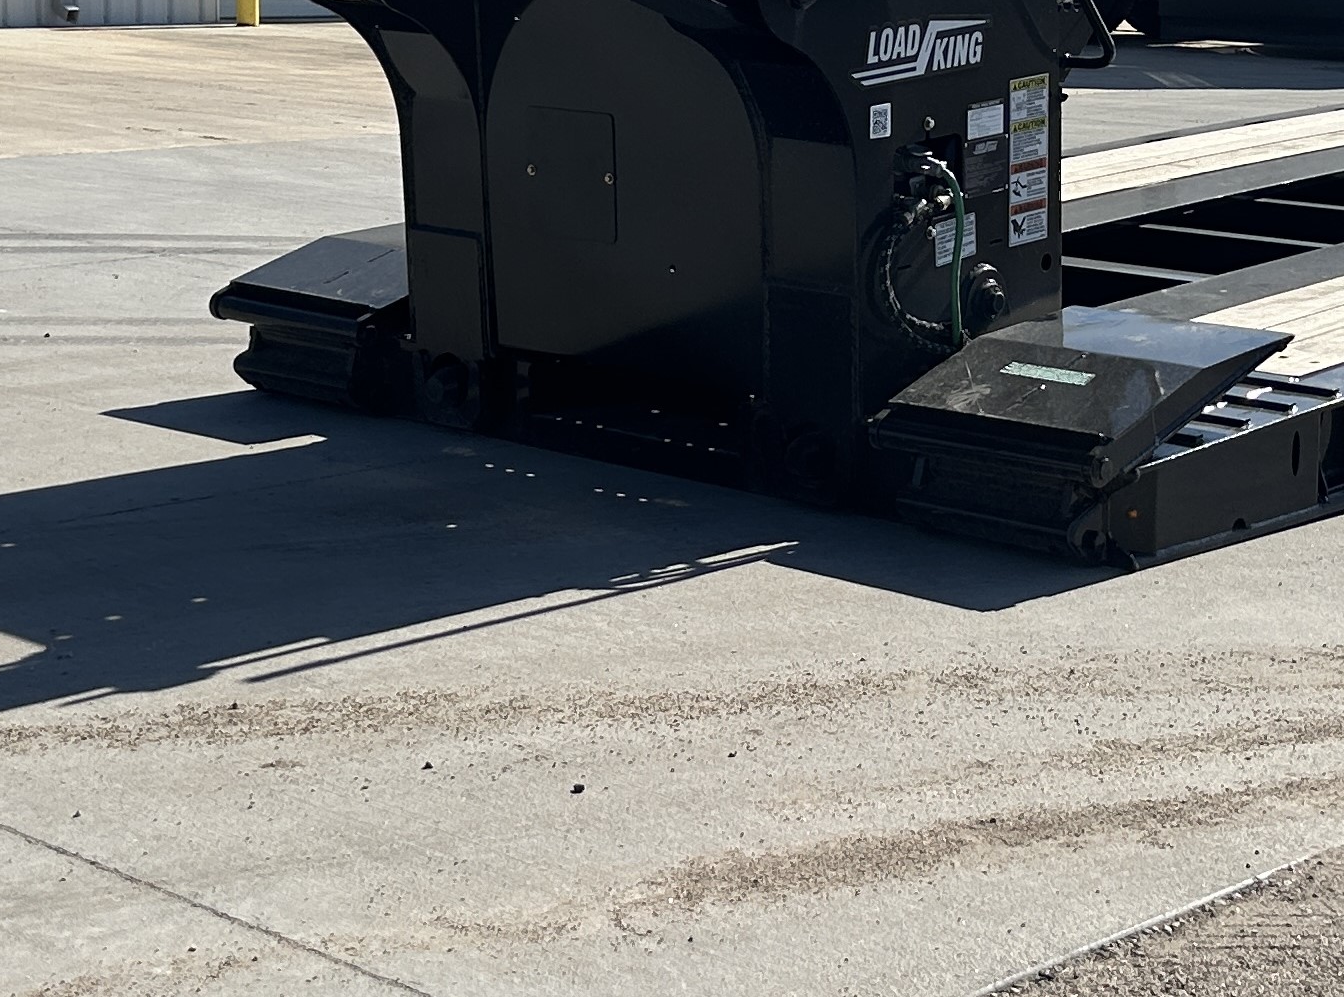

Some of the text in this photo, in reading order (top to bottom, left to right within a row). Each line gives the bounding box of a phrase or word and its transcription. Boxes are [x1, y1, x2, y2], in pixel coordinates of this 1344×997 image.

[867, 23, 984, 71] LOAD KING
[1017, 78, 1046, 90] CAUTION
[1017, 119, 1046, 131] CAUTION
